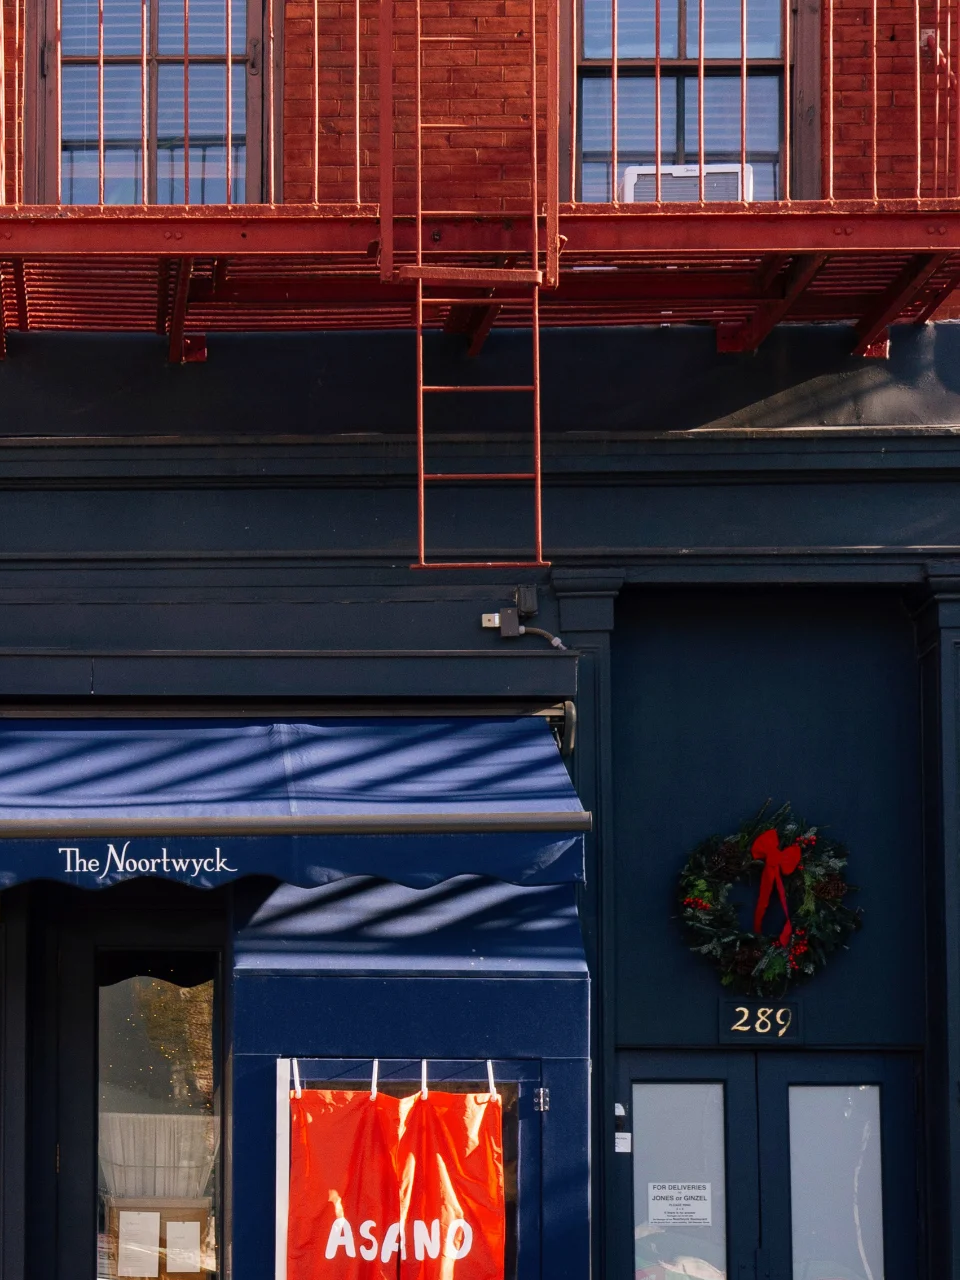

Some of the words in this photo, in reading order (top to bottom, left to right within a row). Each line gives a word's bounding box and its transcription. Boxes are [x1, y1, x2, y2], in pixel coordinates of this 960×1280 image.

[58, 847, 100, 873] The
[99, 841, 238, 879] Noortwyck
[730, 1006, 792, 1037] 289
[324, 1216, 474, 1264] ASANO
